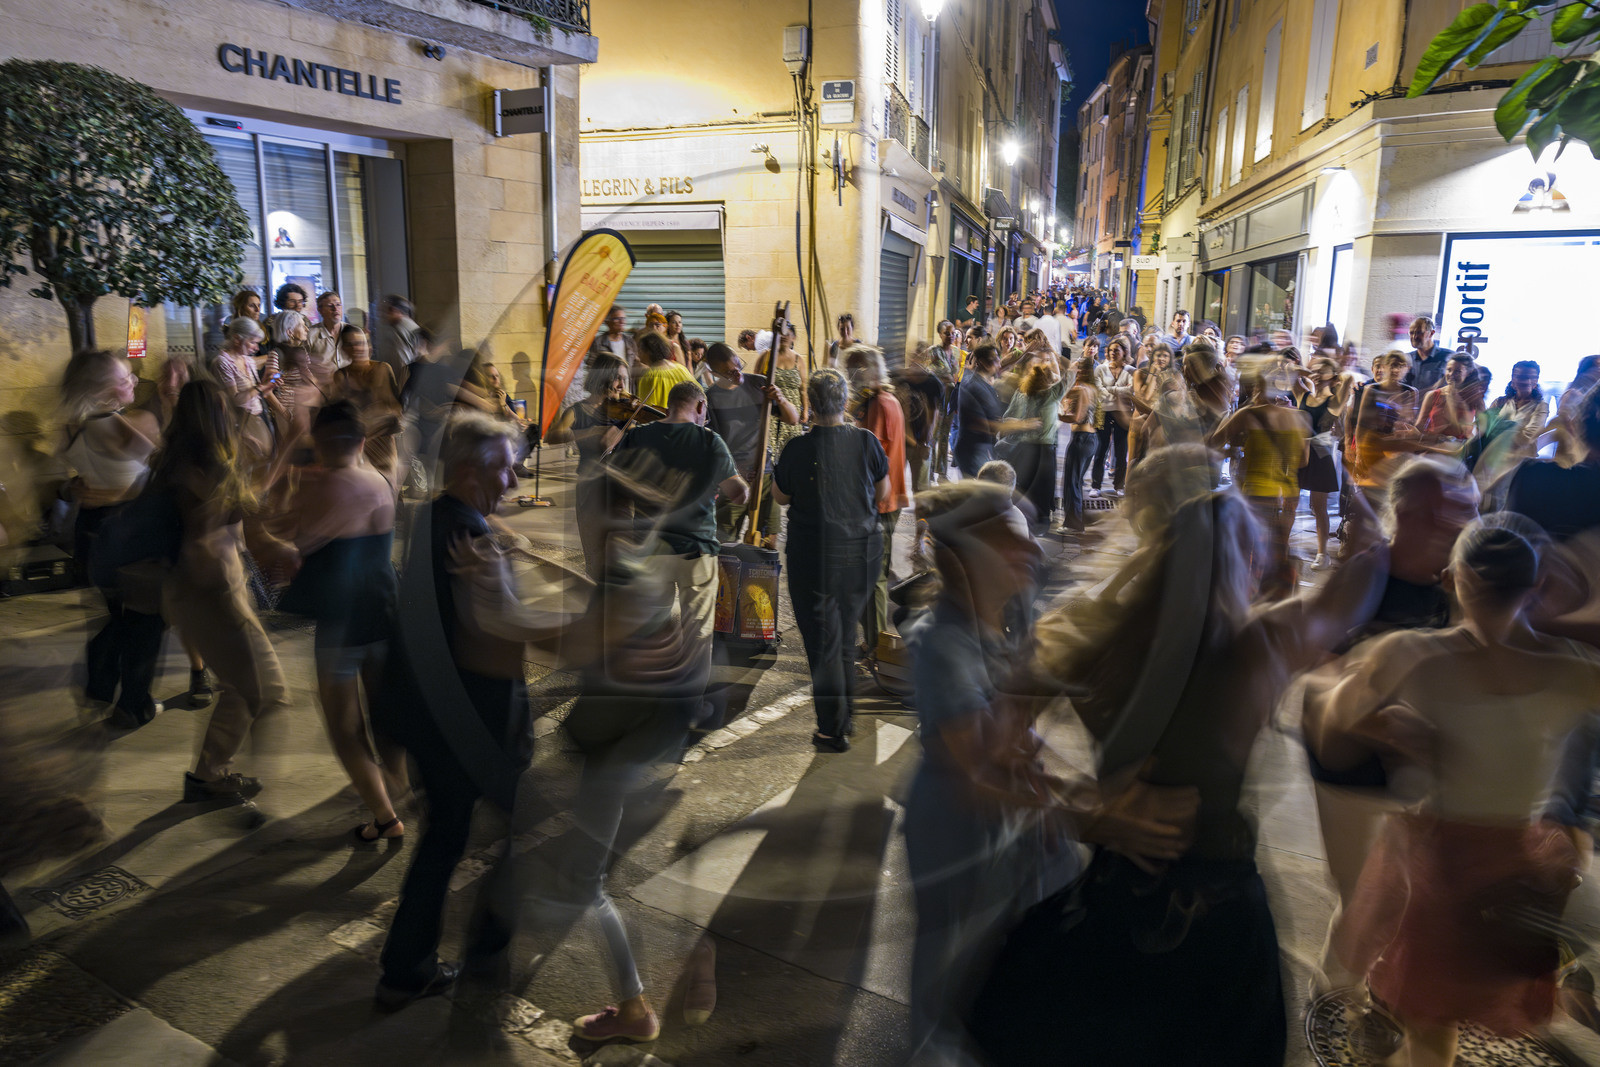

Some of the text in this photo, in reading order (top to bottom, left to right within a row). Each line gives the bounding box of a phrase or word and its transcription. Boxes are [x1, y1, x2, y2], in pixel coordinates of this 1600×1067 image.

[218, 42, 402, 105] CHANTELLE
[501, 104, 544, 118] CHANTELLE
[580, 176, 694, 197] LEGRIN & FILS
